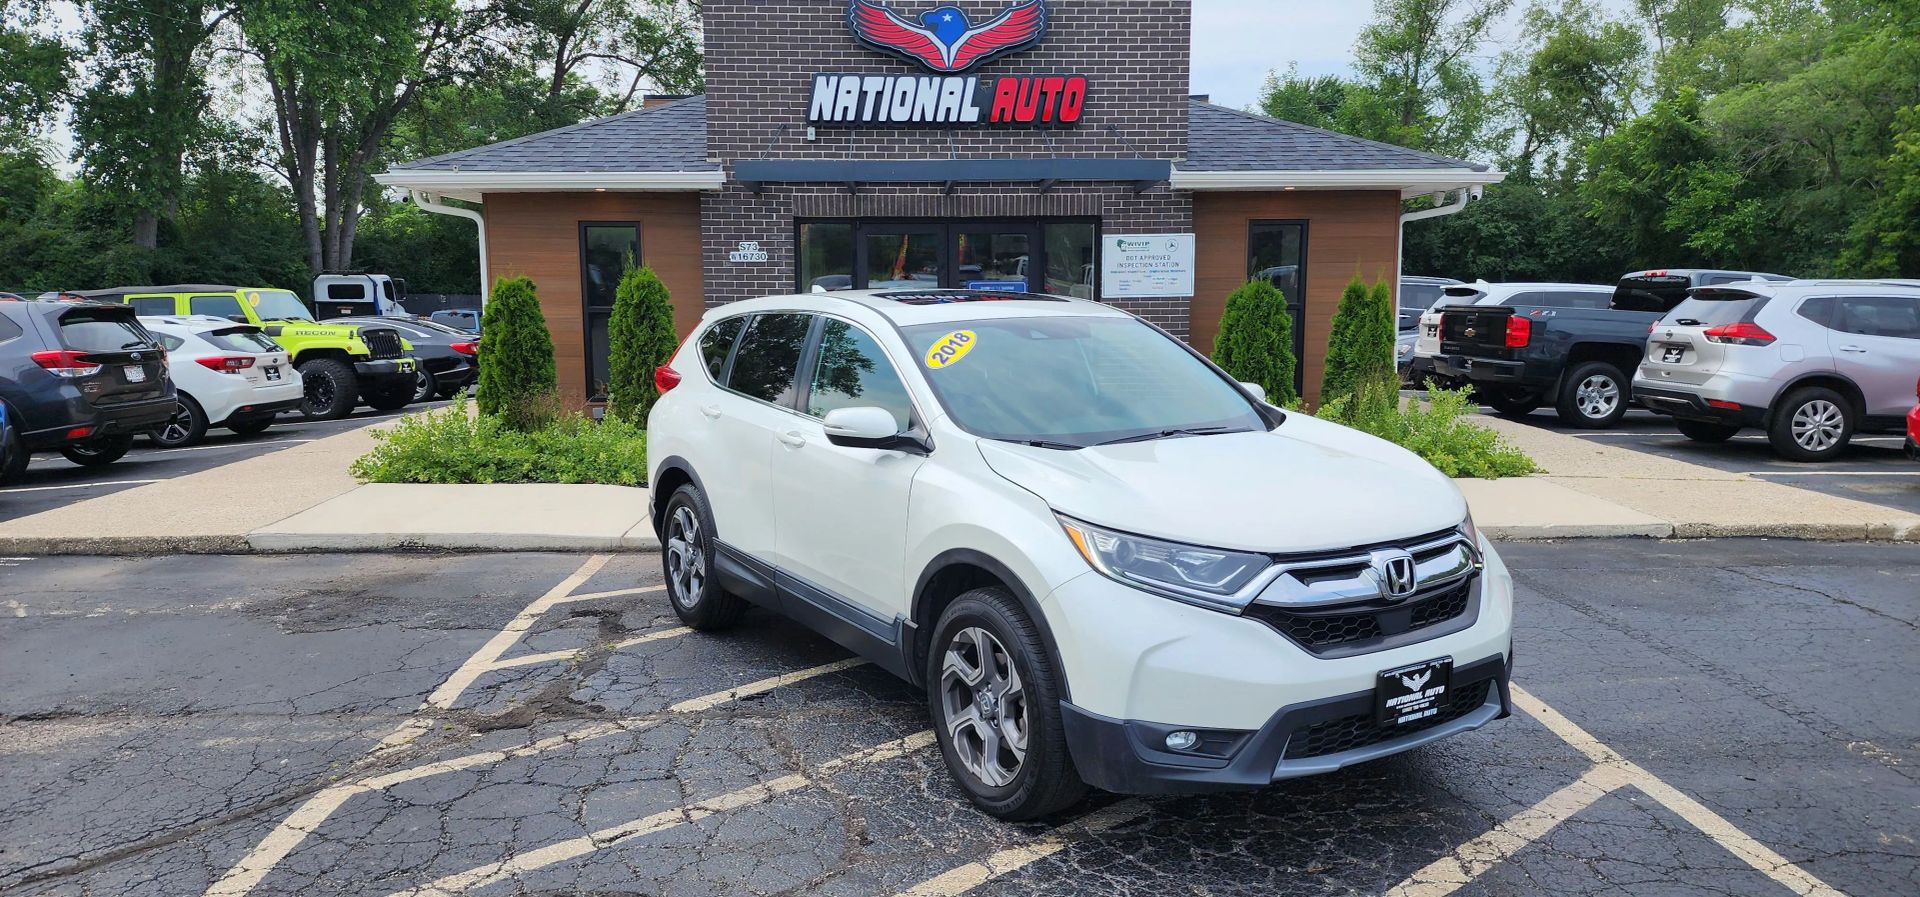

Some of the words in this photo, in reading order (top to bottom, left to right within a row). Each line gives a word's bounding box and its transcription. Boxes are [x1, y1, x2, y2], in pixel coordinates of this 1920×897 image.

[809, 75, 980, 122] NATIONAL
[989, 77, 1087, 122] AUTO
[740, 242, 758, 251] S73
[931, 332, 971, 365] 2018
[1386, 691, 1423, 708] NATIONAL
[1424, 685, 1445, 698] AUTO
[1423, 707, 1438, 718] AUTO
